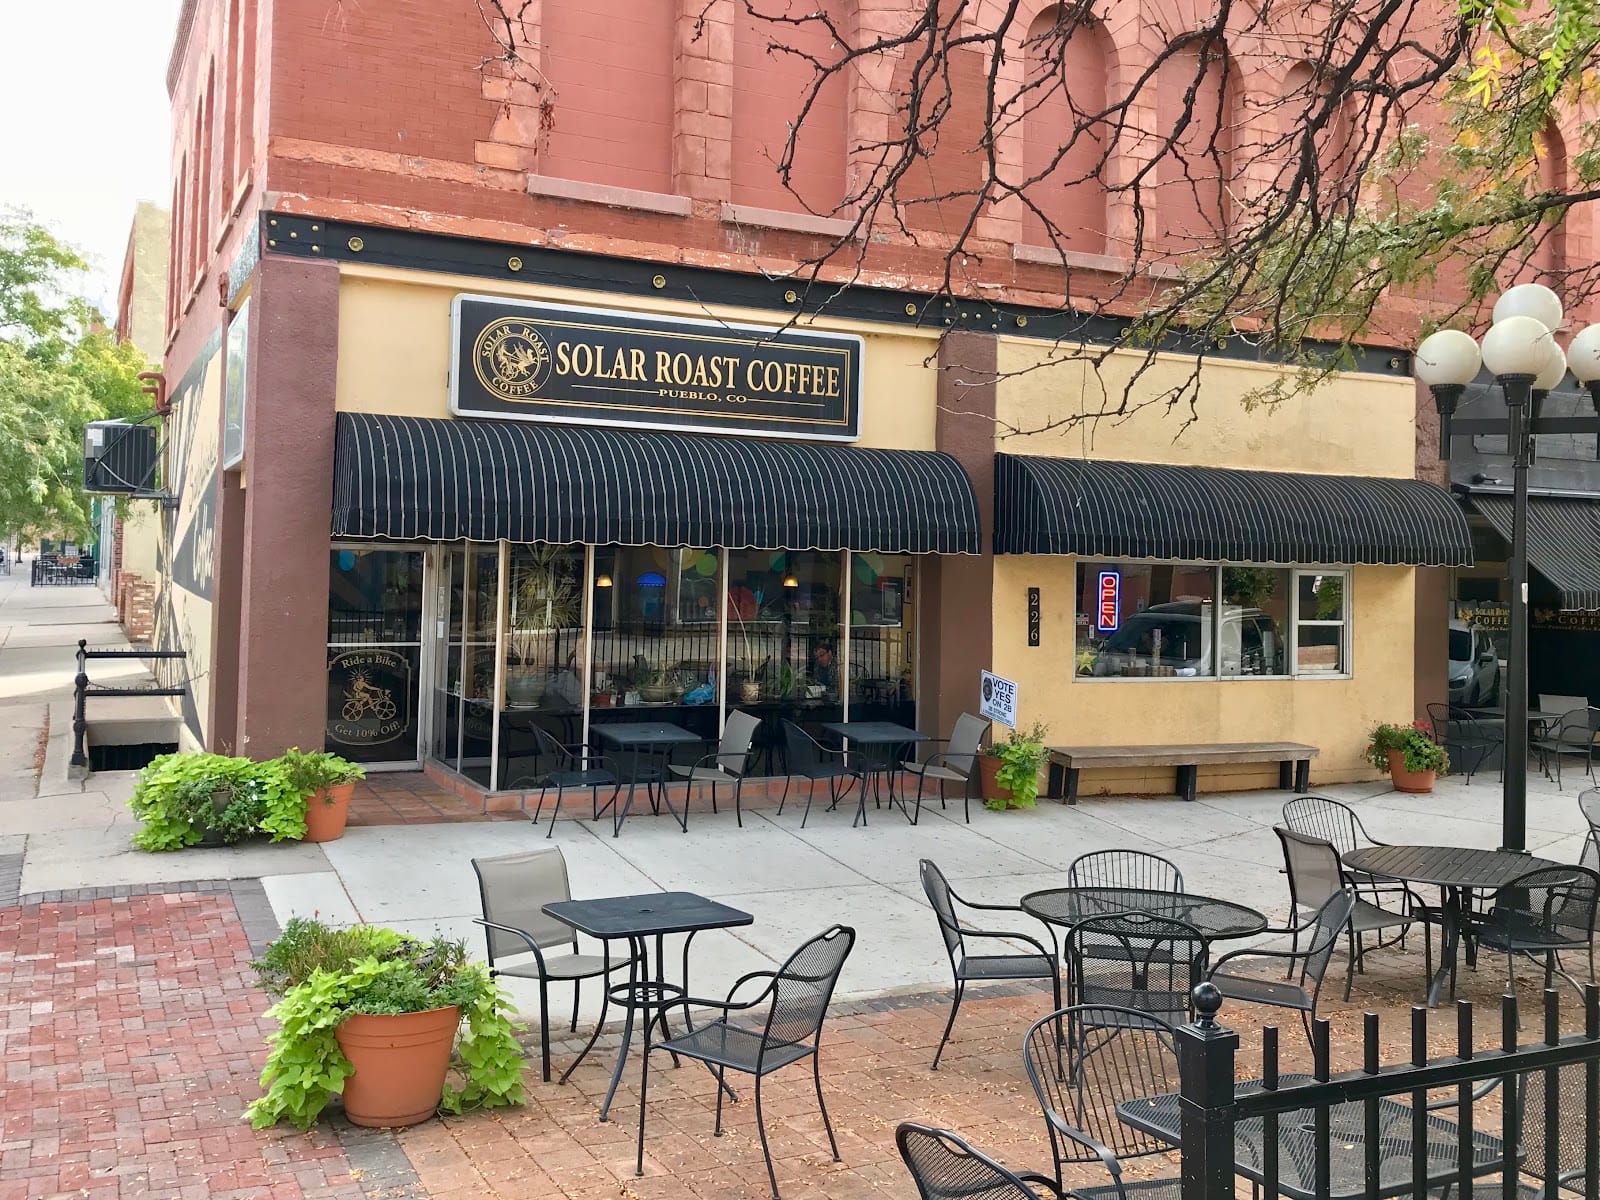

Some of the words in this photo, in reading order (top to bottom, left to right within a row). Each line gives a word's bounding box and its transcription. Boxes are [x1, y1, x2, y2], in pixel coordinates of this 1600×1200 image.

[482, 325, 512, 358] SOLAR
[522, 327, 550, 363] ROAST
[555, 341, 648, 382] SOLAR
[655, 351, 740, 389] ROAST
[746, 359, 840, 397] COFFEE
[492, 376, 539, 395] COFFEE
[658, 388, 722, 402] PUEBLO,
[726, 394, 748, 403] CO
[1101, 576, 1116, 627] OPEN
[1030, 593, 1039, 641] 226
[1475, 615, 1509, 625] COFFE
[341, 655, 365, 669] Ride
[374, 654, 397, 668] Bike
[992, 677, 1014, 695] VOTE
[994, 688, 1011, 704] YES
[992, 698, 1002, 709] ON
[1003, 703, 1012, 713] 2B
[335, 723, 352, 736] Get
[356, 728, 378, 738] 10%
